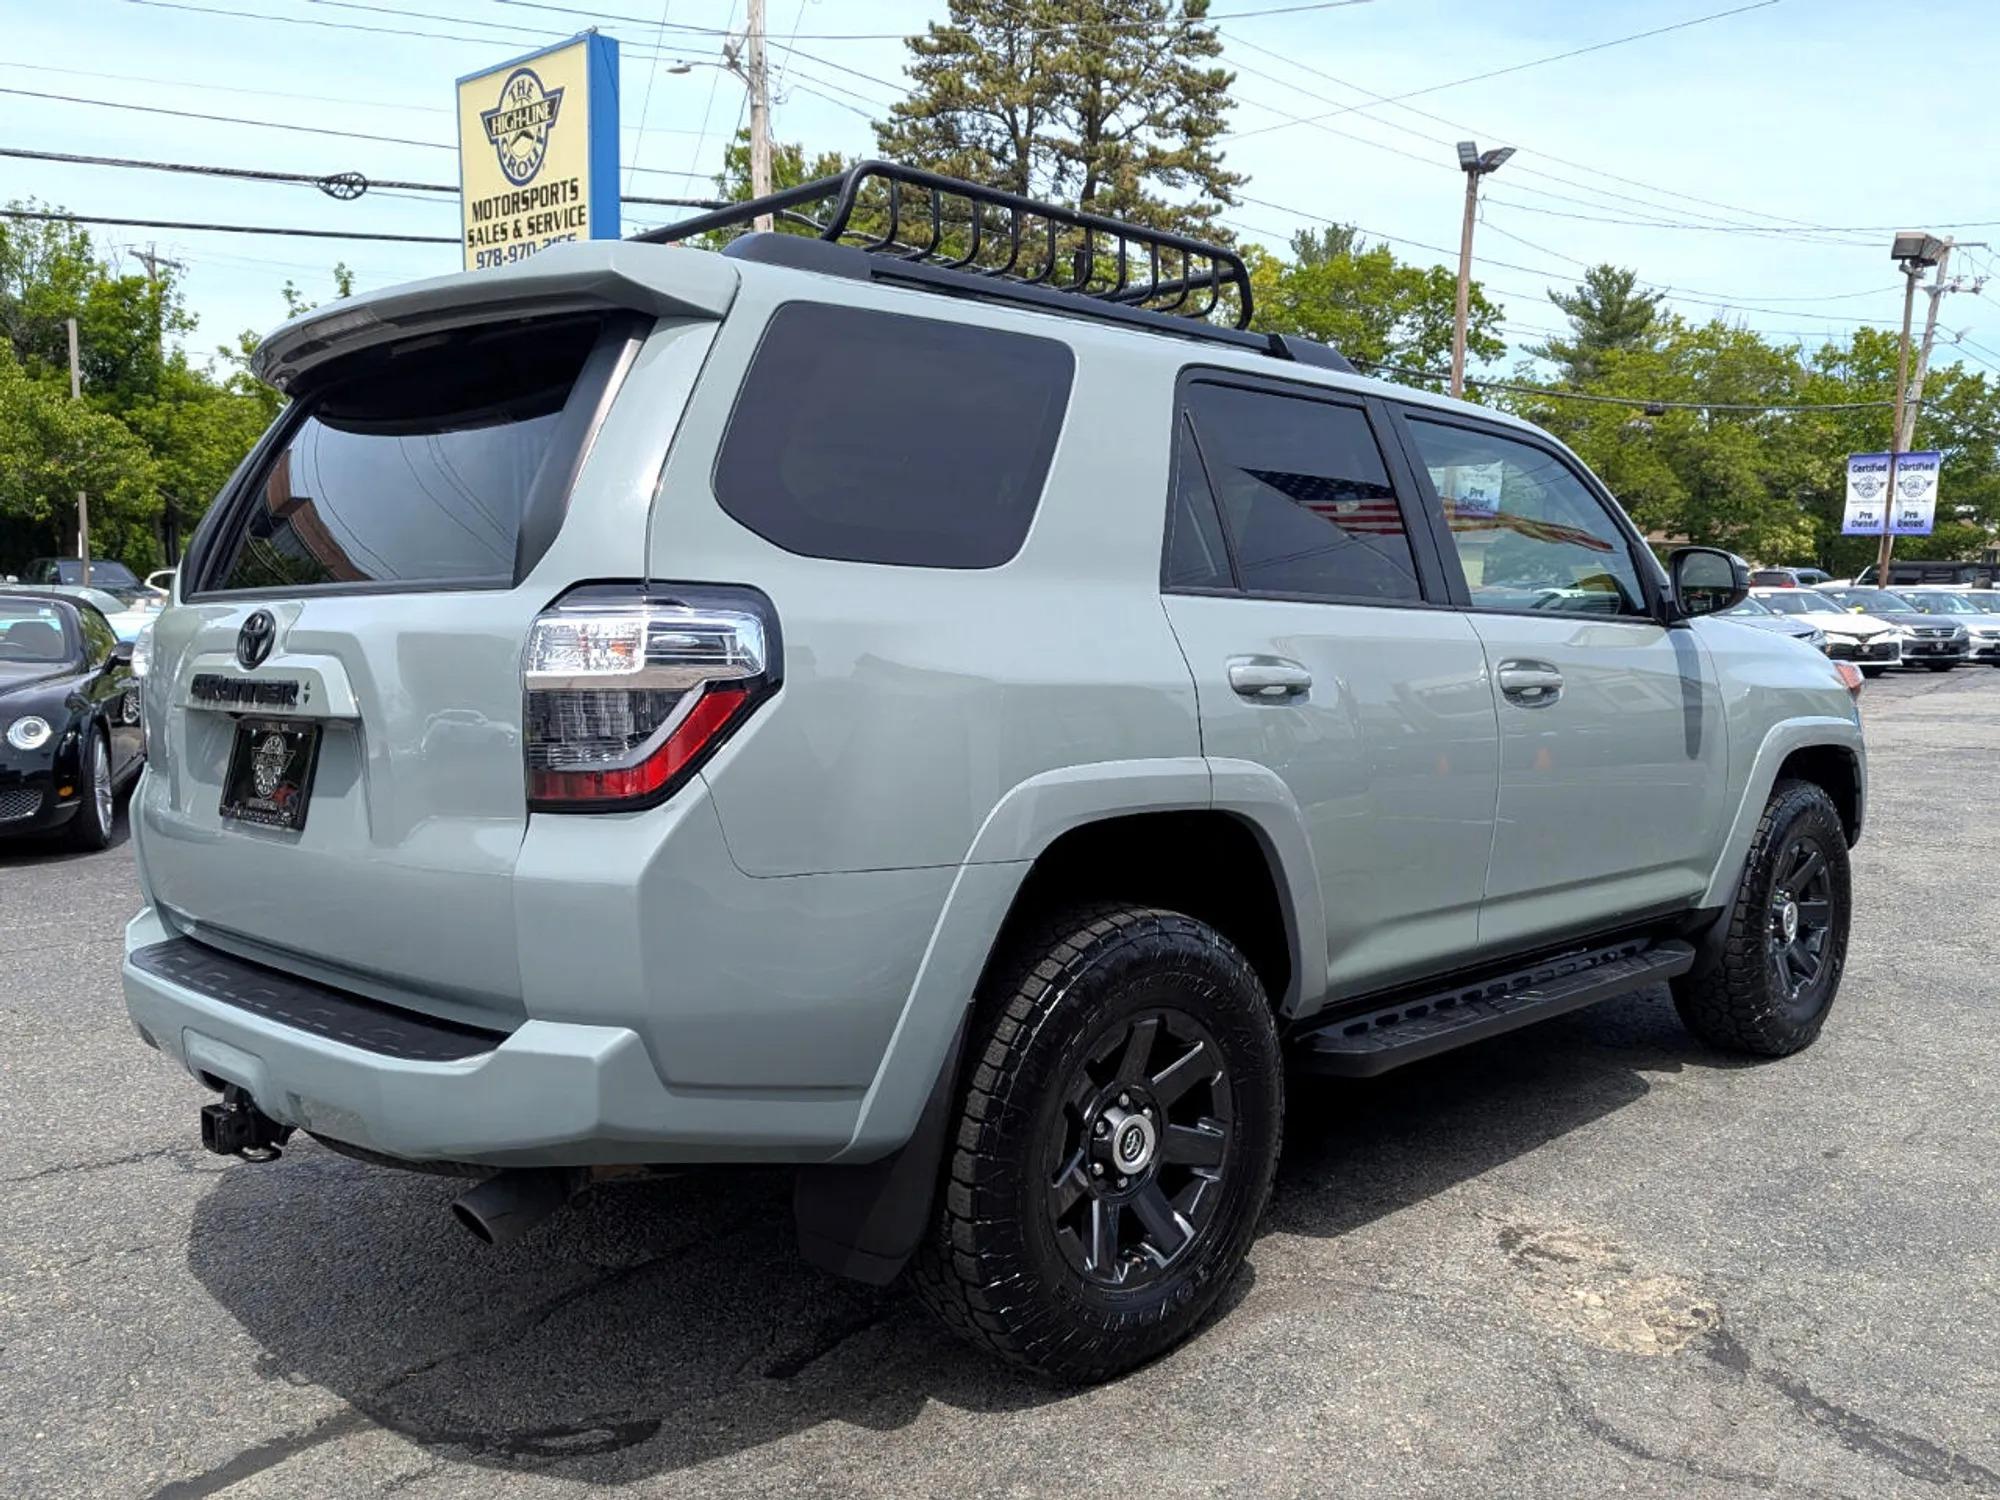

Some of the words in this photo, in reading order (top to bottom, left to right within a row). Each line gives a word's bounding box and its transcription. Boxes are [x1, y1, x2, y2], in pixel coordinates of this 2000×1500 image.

[508, 79, 533, 102] THE
[492, 102, 552, 135] HIGH-LINE
[472, 178, 578, 223] MOTORSPORTS
[467, 222, 508, 248] SALES
[512, 219, 523, 239] &
[526, 205, 586, 236] SERVICE
[1851, 463, 1887, 473] Certified
[1898, 462, 1936, 473] Certified
